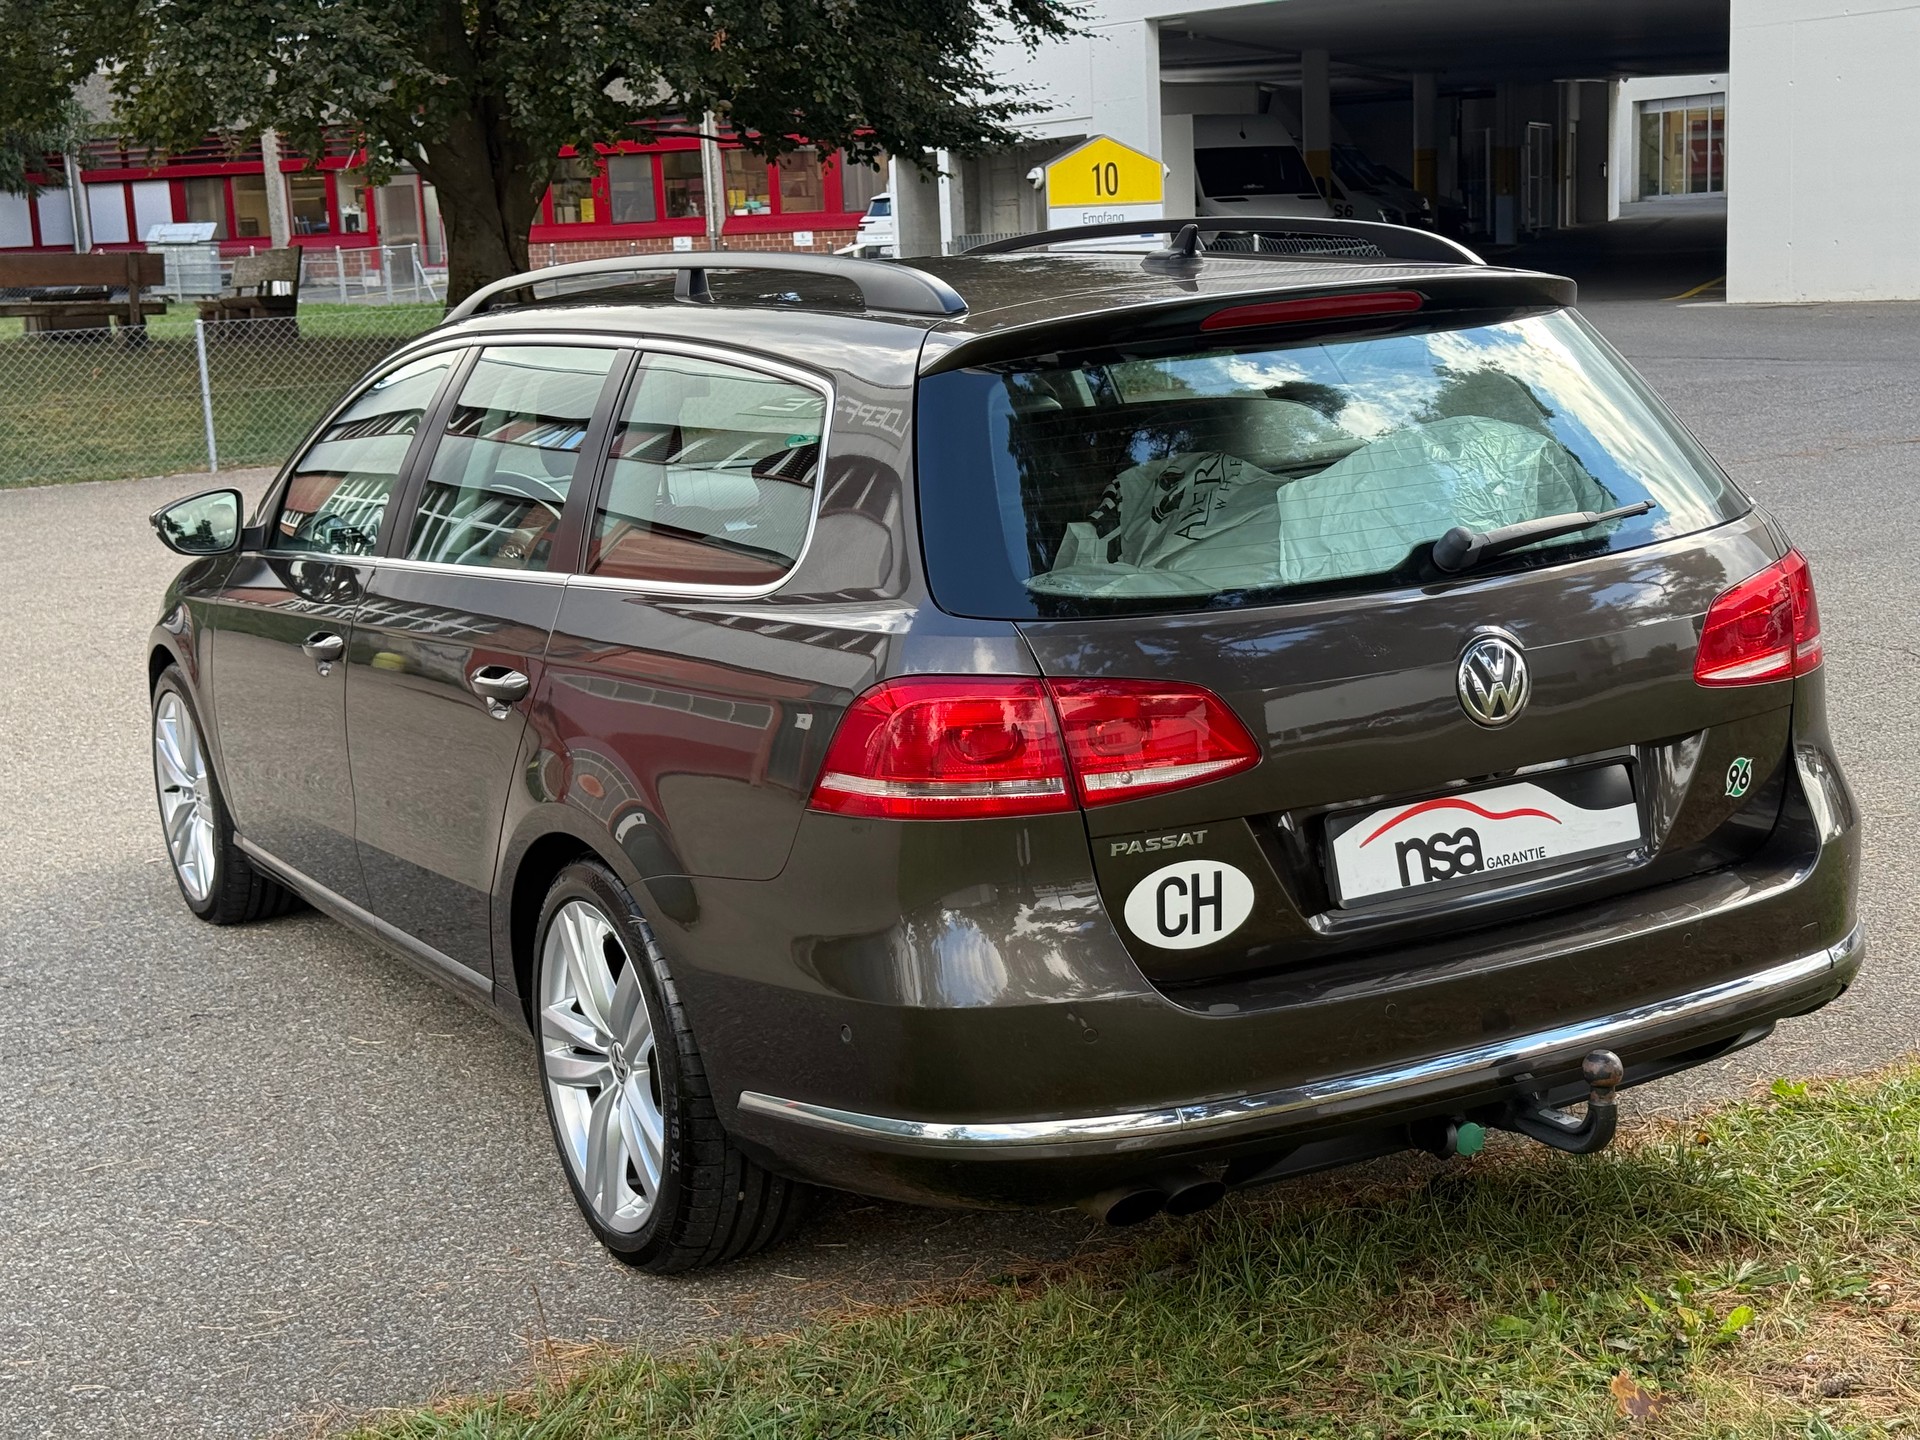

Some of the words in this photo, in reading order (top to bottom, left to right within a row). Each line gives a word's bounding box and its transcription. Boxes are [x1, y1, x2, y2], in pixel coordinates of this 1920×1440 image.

[1092, 162, 1118, 196] 10
[1334, 203, 1354, 218] S6
[1459, 638, 1528, 726] VW
[1727, 759, 1751, 795] 96
[1110, 830, 1208, 857] PASSAT
[1395, 827, 1485, 887] nsa
[1487, 846, 1546, 869] GARANTIE
[1156, 870, 1222, 938] CH
[670, 1148, 680, 1174] XL
